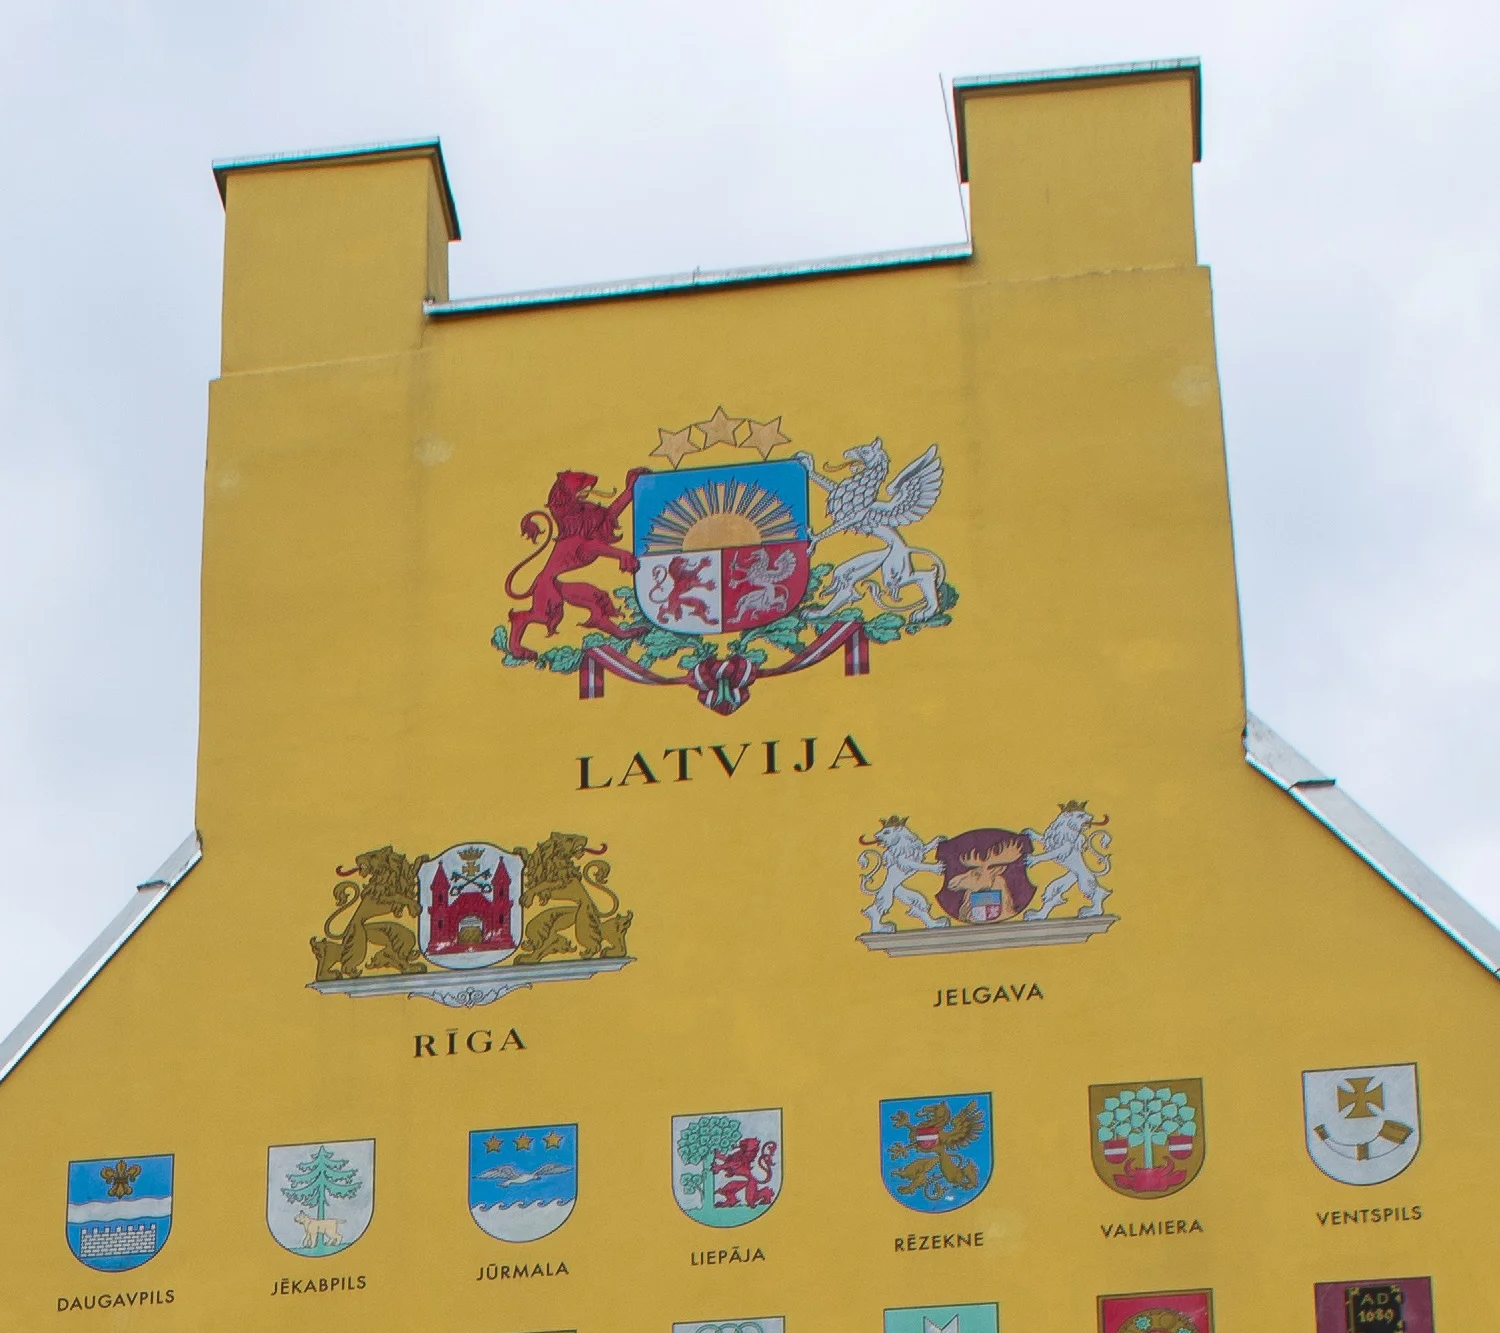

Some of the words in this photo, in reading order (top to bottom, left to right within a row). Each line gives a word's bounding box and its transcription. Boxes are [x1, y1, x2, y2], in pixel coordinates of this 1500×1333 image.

[576, 735, 872, 790] LATVIJA
[933, 983, 1043, 1007] JELGAVA
[414, 1028, 526, 1058] RĪGA
[1315, 1205, 1422, 1227] VENTSPILS
[1100, 1219, 1204, 1239] VALMIERA
[894, 1231, 984, 1253] RĒZEKNE
[690, 1245, 766, 1267] LIEPĀJA
[475, 1261, 570, 1282] JŪRMALA
[270, 1275, 367, 1296] JĒKABPILS
[57, 1289, 175, 1313] DAUGAVPILS
